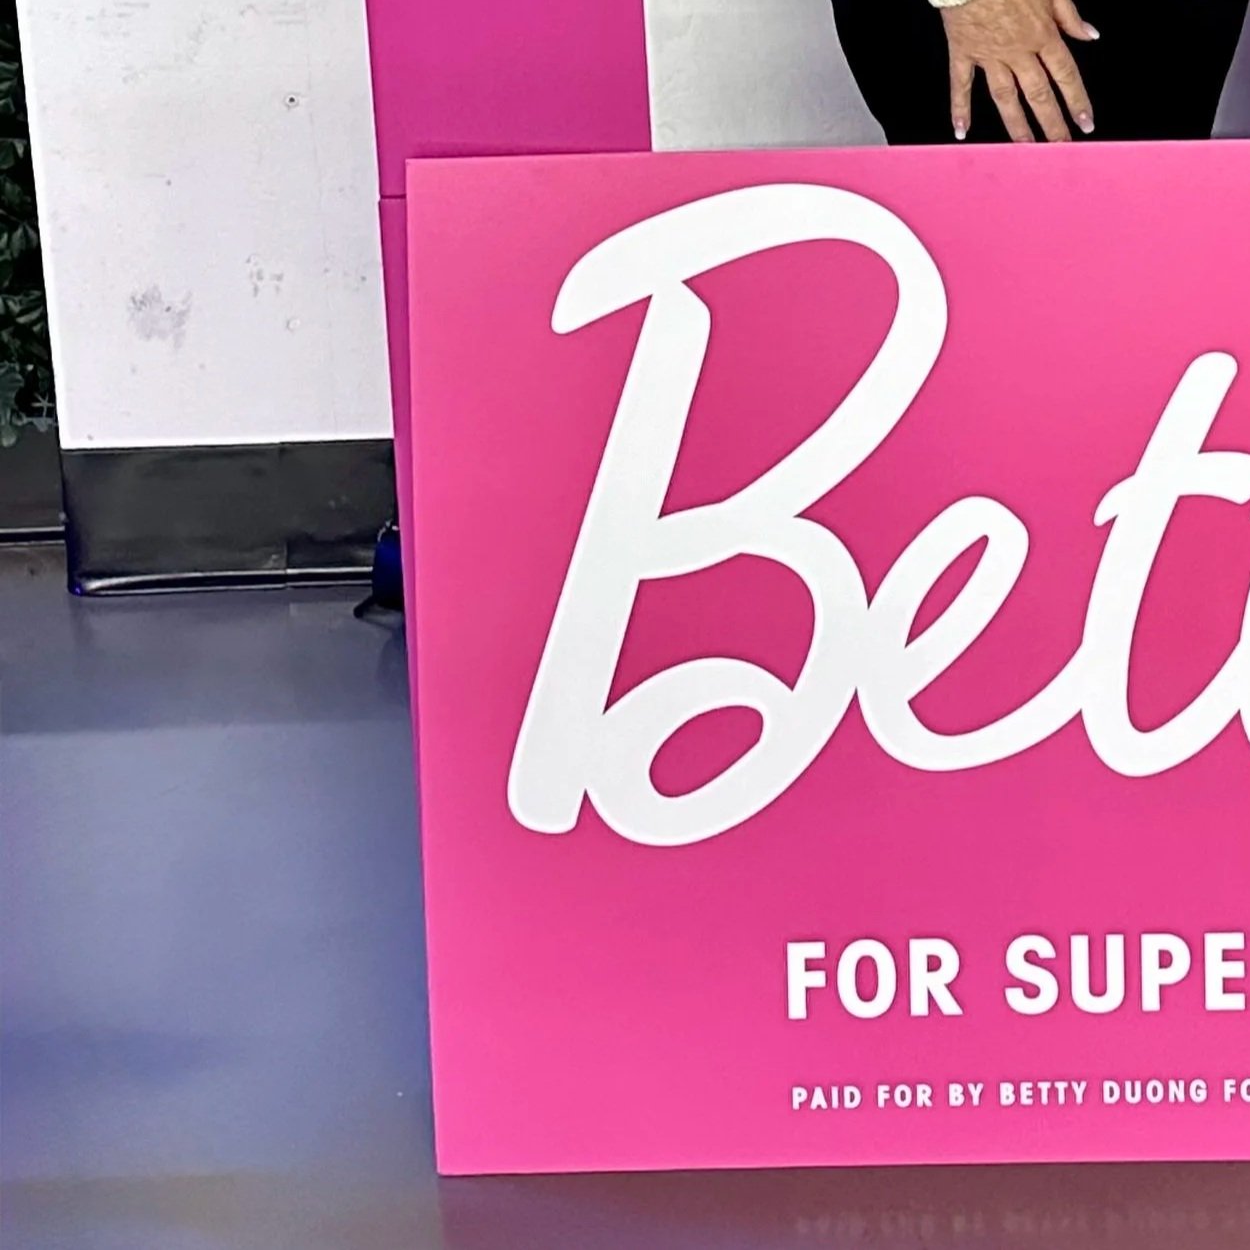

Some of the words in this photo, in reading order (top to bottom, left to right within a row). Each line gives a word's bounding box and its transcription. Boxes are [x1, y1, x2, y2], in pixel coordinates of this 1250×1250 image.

[786, 937, 963, 1020] FOR
[791, 1085, 862, 1110] PAID
[876, 1084, 932, 1108] FOR
[948, 1082, 984, 1107] BY
[999, 1081, 1087, 1106] BETTY
[1102, 1079, 1207, 1104] DUONG
